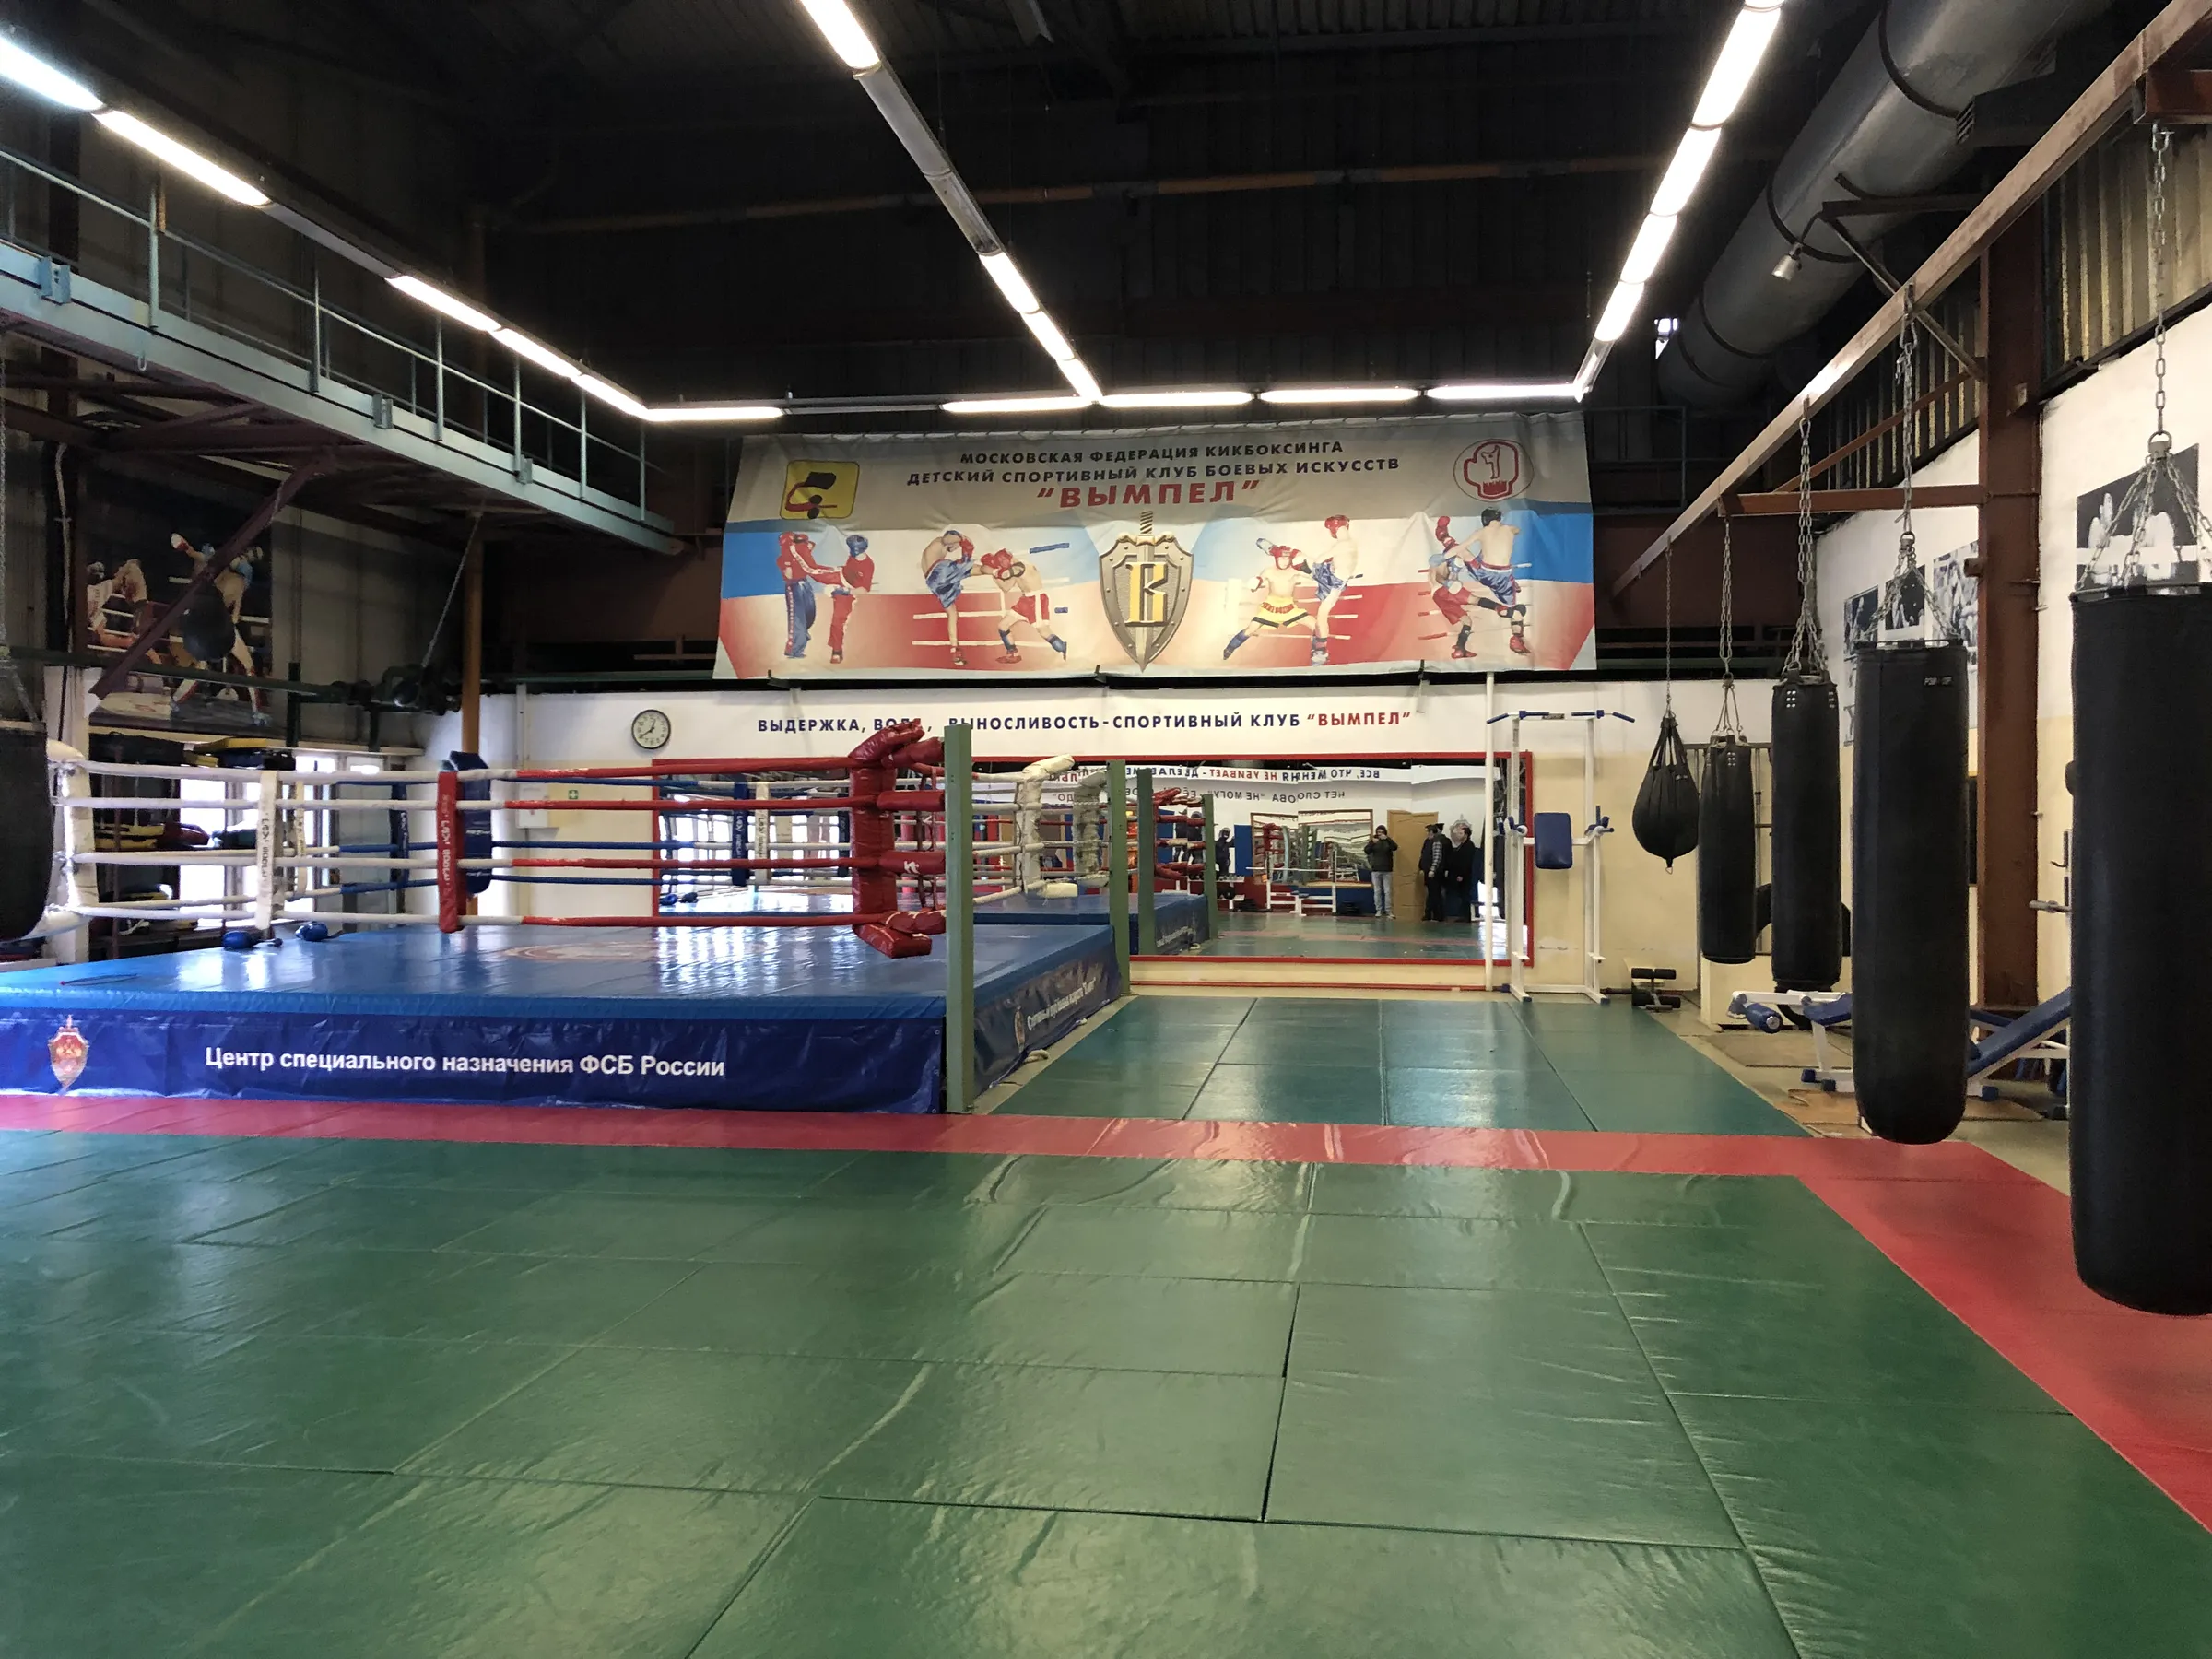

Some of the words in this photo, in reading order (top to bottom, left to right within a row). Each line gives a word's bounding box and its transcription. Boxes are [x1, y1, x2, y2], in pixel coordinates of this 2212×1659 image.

[960, 452, 1083, 465] МОСКОВСКАЯ
[1090, 446, 1198, 463] ФЕДЕРАЦИЯ
[1206, 441, 1343, 458] КИКБОКСИНГА
[907, 468, 994, 486] ДЕТСКИЙ
[1002, 465, 1137, 483] СПОРТИВНЫЙ
[1146, 465, 1197, 478] КЛУБ
[1205, 462, 1288, 477] БОЕВЫХ
[1295, 458, 1399, 474] ИСКУССТВ
[758, 719, 866, 734] ВЫДЕРЖКА,
[1250, 714, 1300, 726] КЛУБ
[206, 1047, 274, 1072] Центр
[280, 1053, 436, 1071] специального
[442, 1056, 573, 1073] назначения
[580, 1055, 634, 1075] ФСБ
[641, 1055, 725, 1076] России
